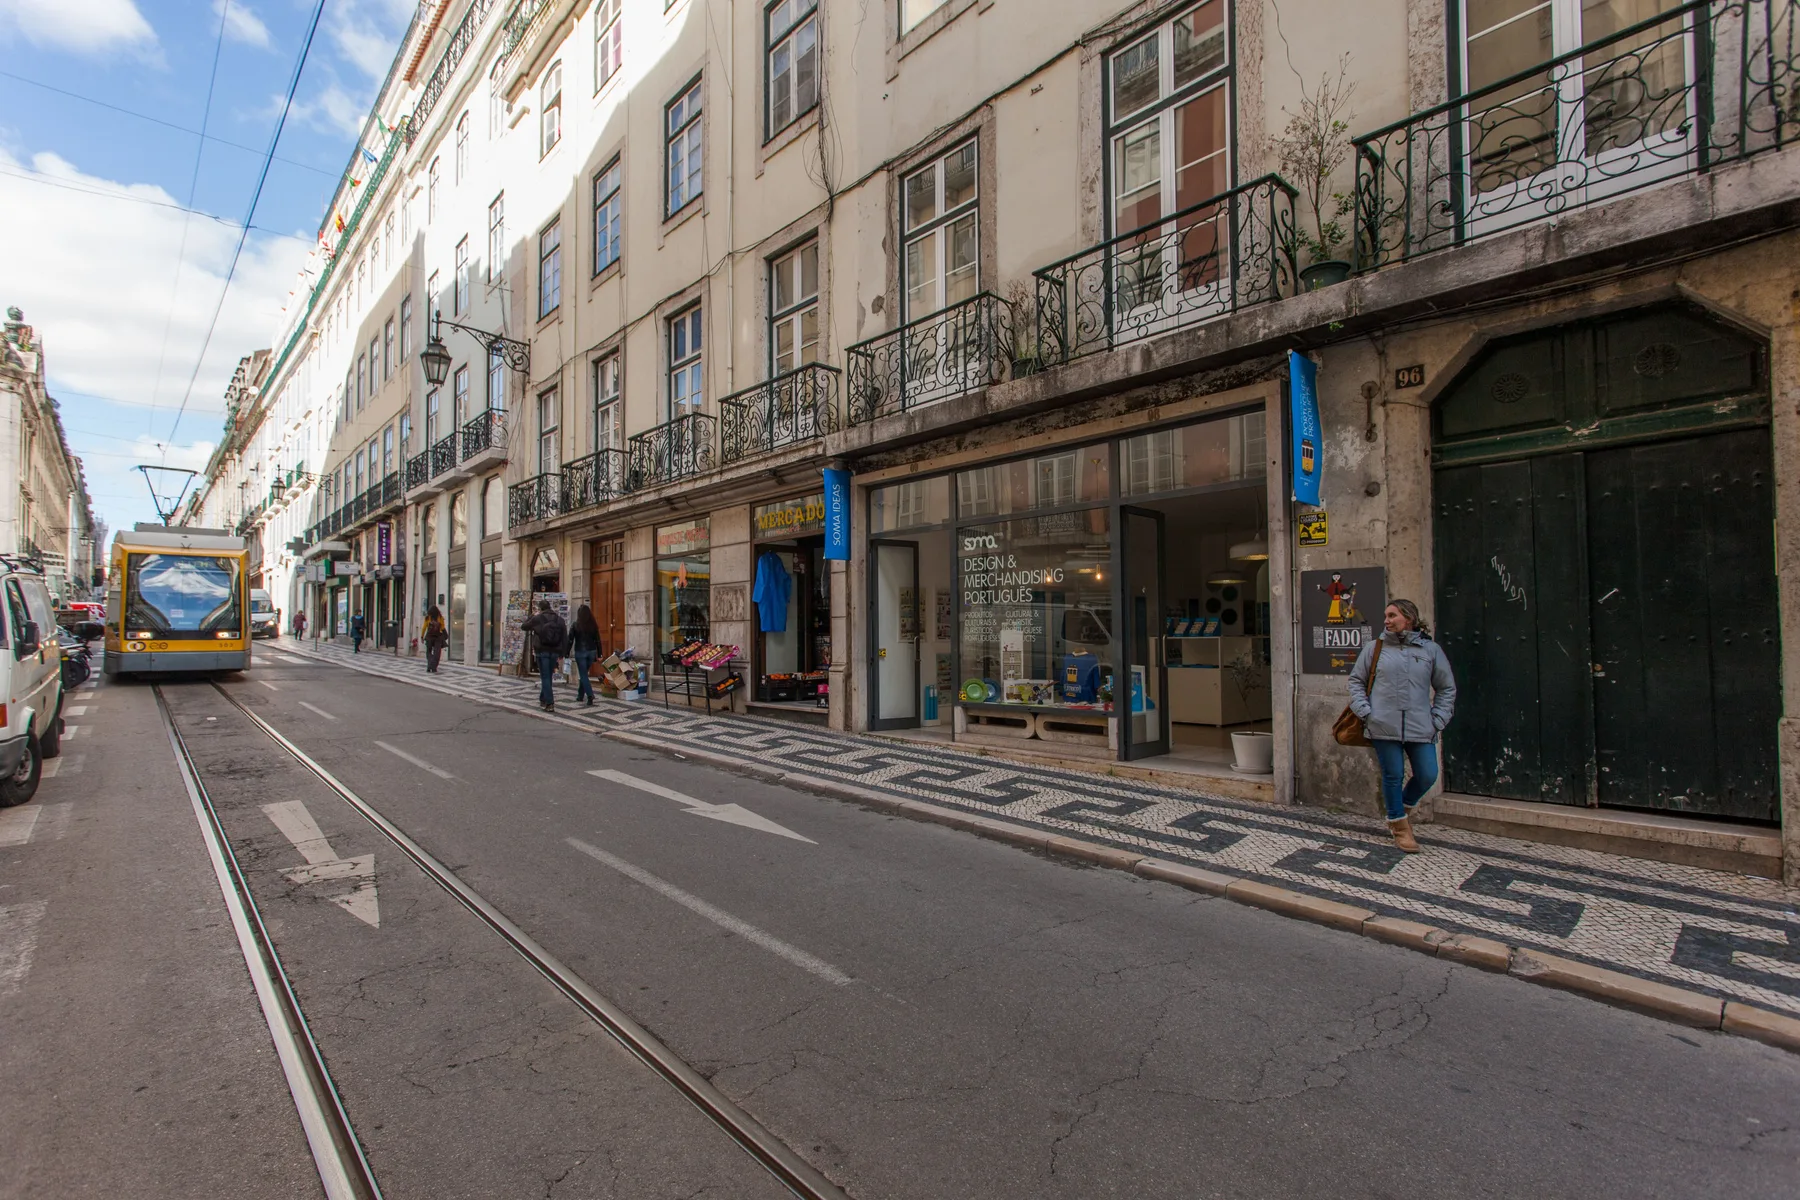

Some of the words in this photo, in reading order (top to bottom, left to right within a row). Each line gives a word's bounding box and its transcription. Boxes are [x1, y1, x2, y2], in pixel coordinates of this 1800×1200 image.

[1398, 367, 1421, 387] 96
[832, 483, 841, 512] IDEAS
[758, 503, 825, 529] MERCADO
[832, 514, 841, 546] SOMA
[964, 555, 1004, 572] DESIGN
[1007, 554, 1017, 569] &
[964, 568, 1064, 588] MERCHANDISING
[964, 586, 1033, 605] PORTUGUÊS
[965, 611, 993, 619] PRODUTOS
[1005, 610, 1033, 618] CULTURAL
[1325, 629, 1361, 647] FADO
